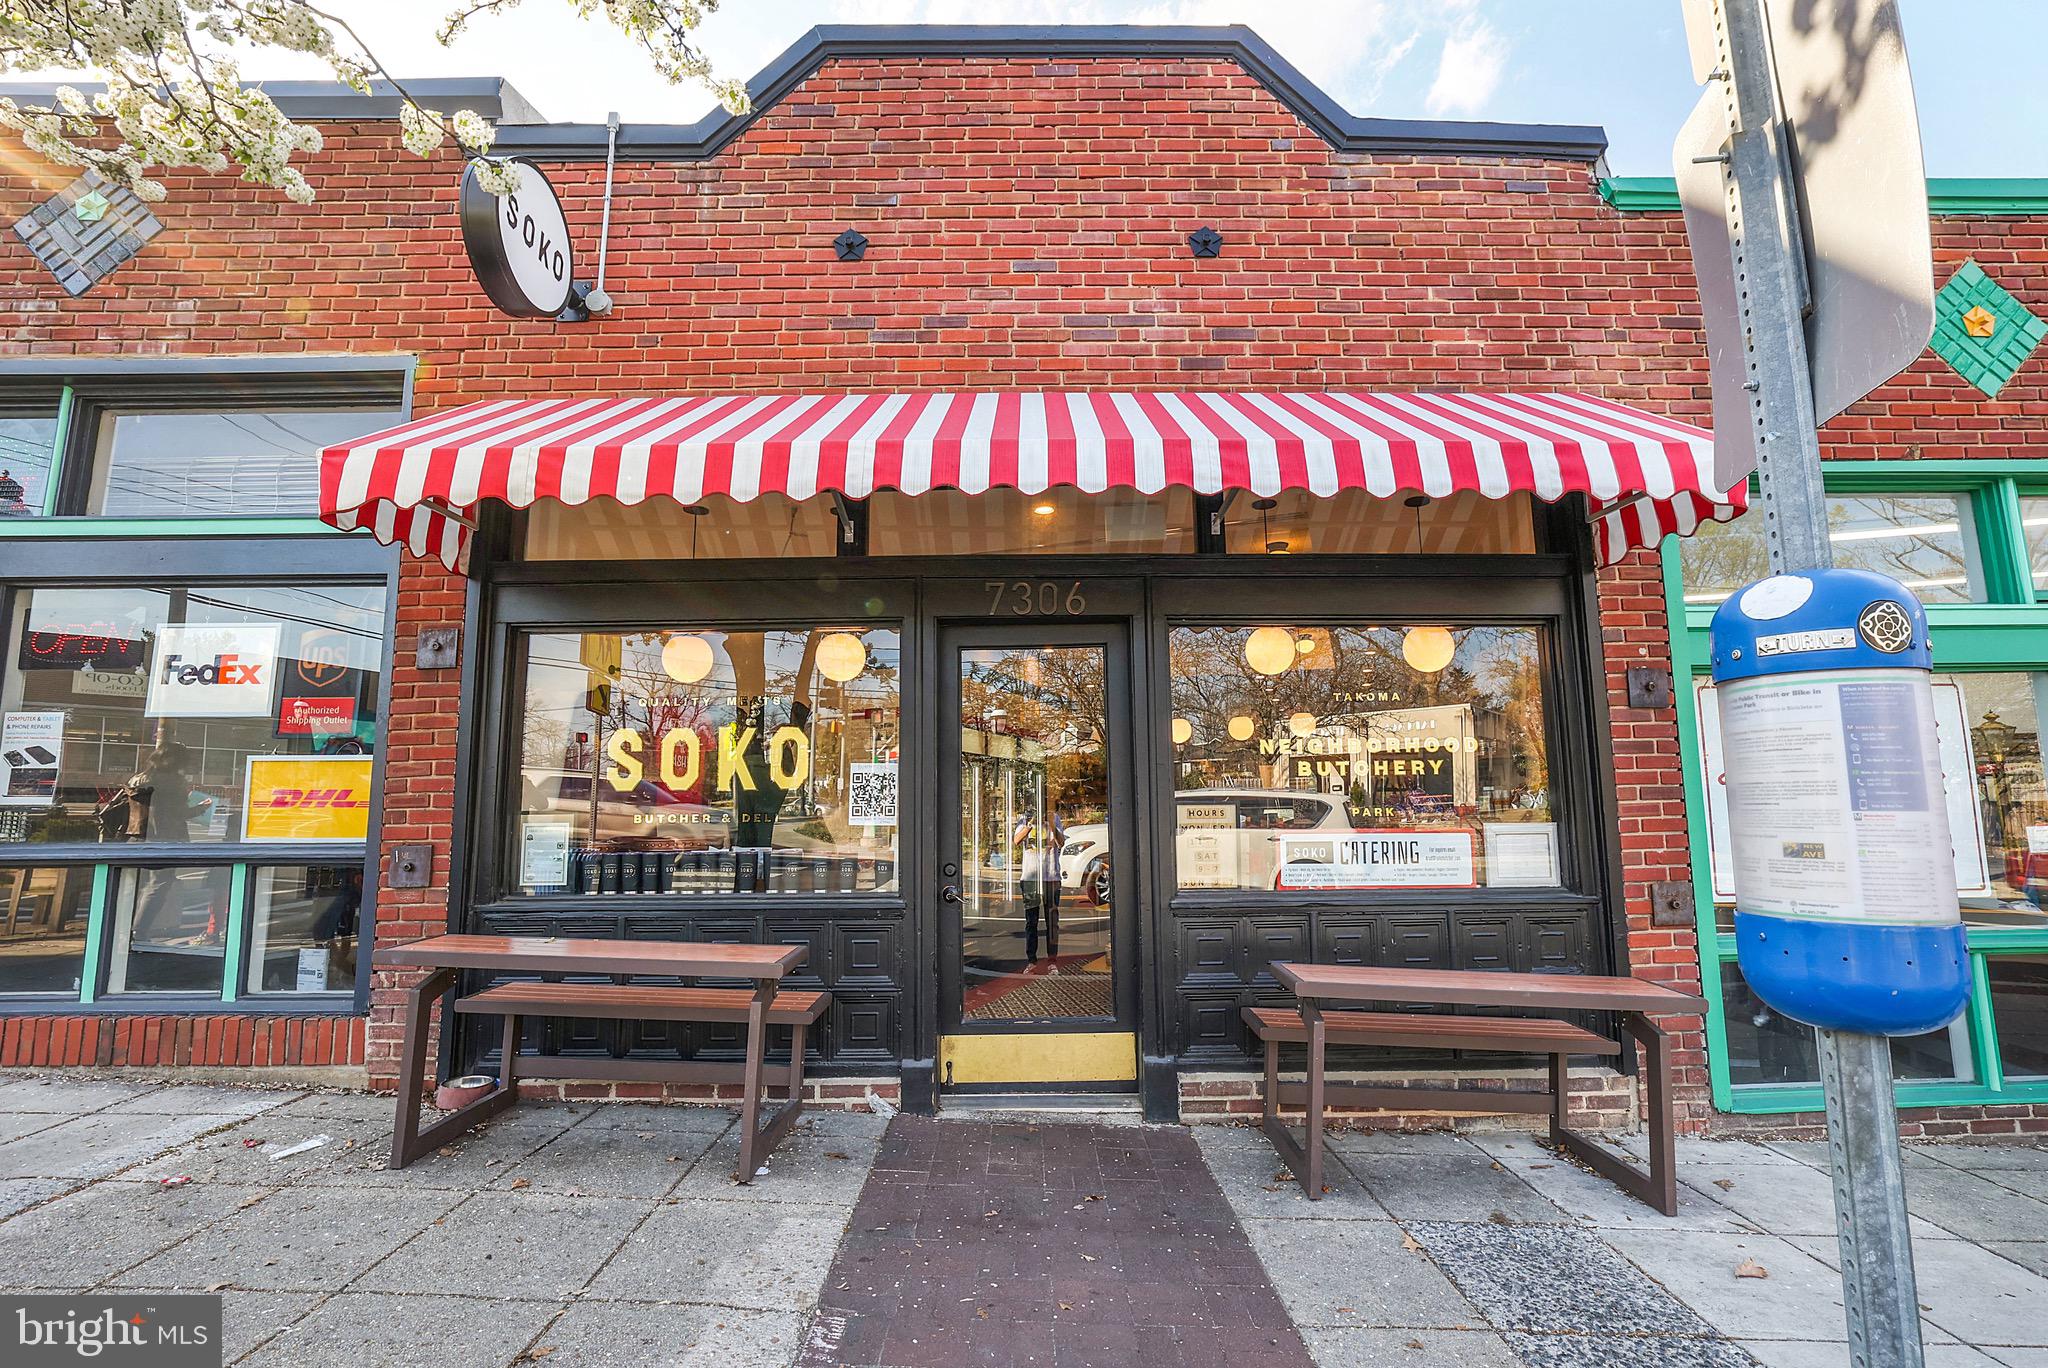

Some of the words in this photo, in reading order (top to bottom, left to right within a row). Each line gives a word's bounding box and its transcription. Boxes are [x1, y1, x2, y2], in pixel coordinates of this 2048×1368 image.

[507, 194, 564, 282] SOKO
[985, 582, 1086, 615] 7306
[31, 623, 136, 654] OPEN
[1776, 632, 1833, 654] TURN
[160, 654, 264, 686] FedEx
[302, 646, 346, 678] ups
[638, 697, 711, 708] QUALITY
[727, 696, 782, 707] MEATS
[1333, 692, 1401, 701] TAKOMA
[296, 706, 340, 714] Authorized
[286, 716, 321, 726] Shipping
[323, 716, 348, 724] Outlet
[1259, 736, 1479, 755] NEIGHBORHOOD
[607, 726, 810, 792] SOKO
[1297, 759, 1444, 777] BUTCHERY
[269, 789, 358, 808] DHL
[633, 813, 711, 824] BUTCHER
[721, 813, 731, 824] &
[742, 813, 779, 824] DELI
[1352, 807, 1395, 817] PARK
[1294, 847, 1326, 858] SOKO
[1340, 841, 1420, 865] CATERING
